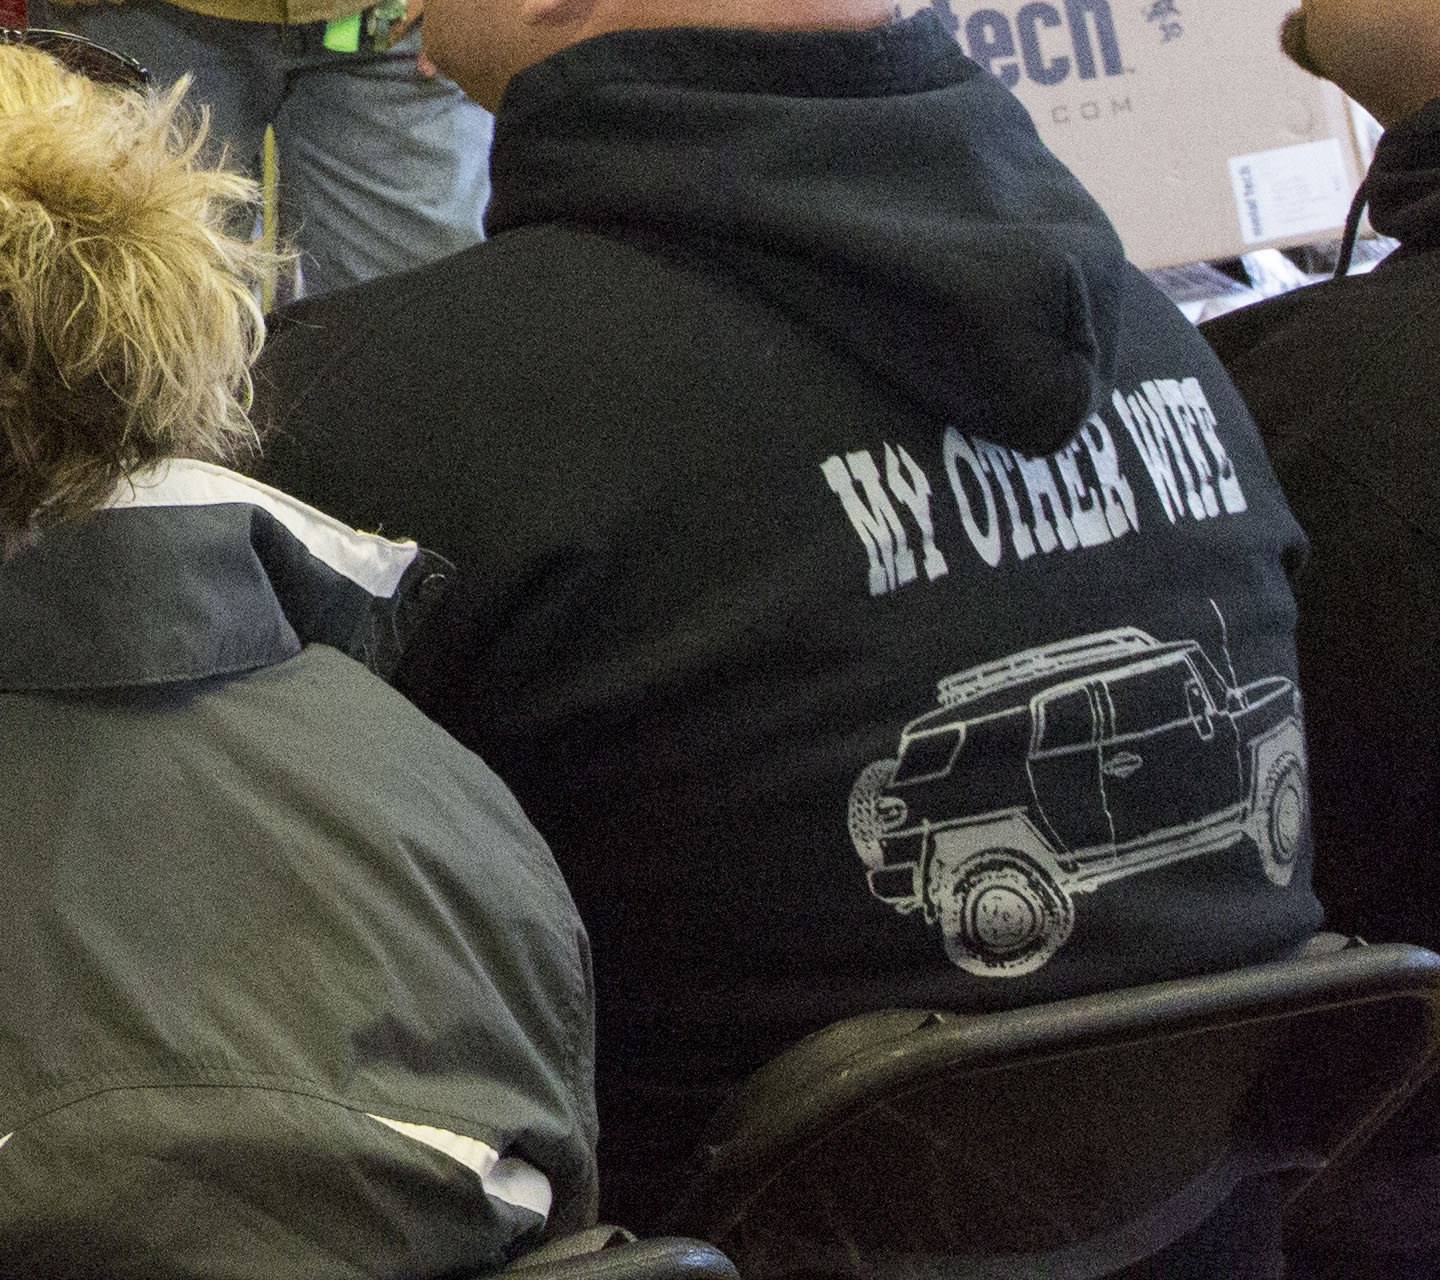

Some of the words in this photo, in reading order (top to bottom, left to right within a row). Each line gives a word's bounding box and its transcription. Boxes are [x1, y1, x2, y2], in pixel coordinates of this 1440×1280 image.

[821, 442, 949, 597] MY
[942, 412, 1140, 568] OTHER
[1111, 376, 1248, 524] WIFE
